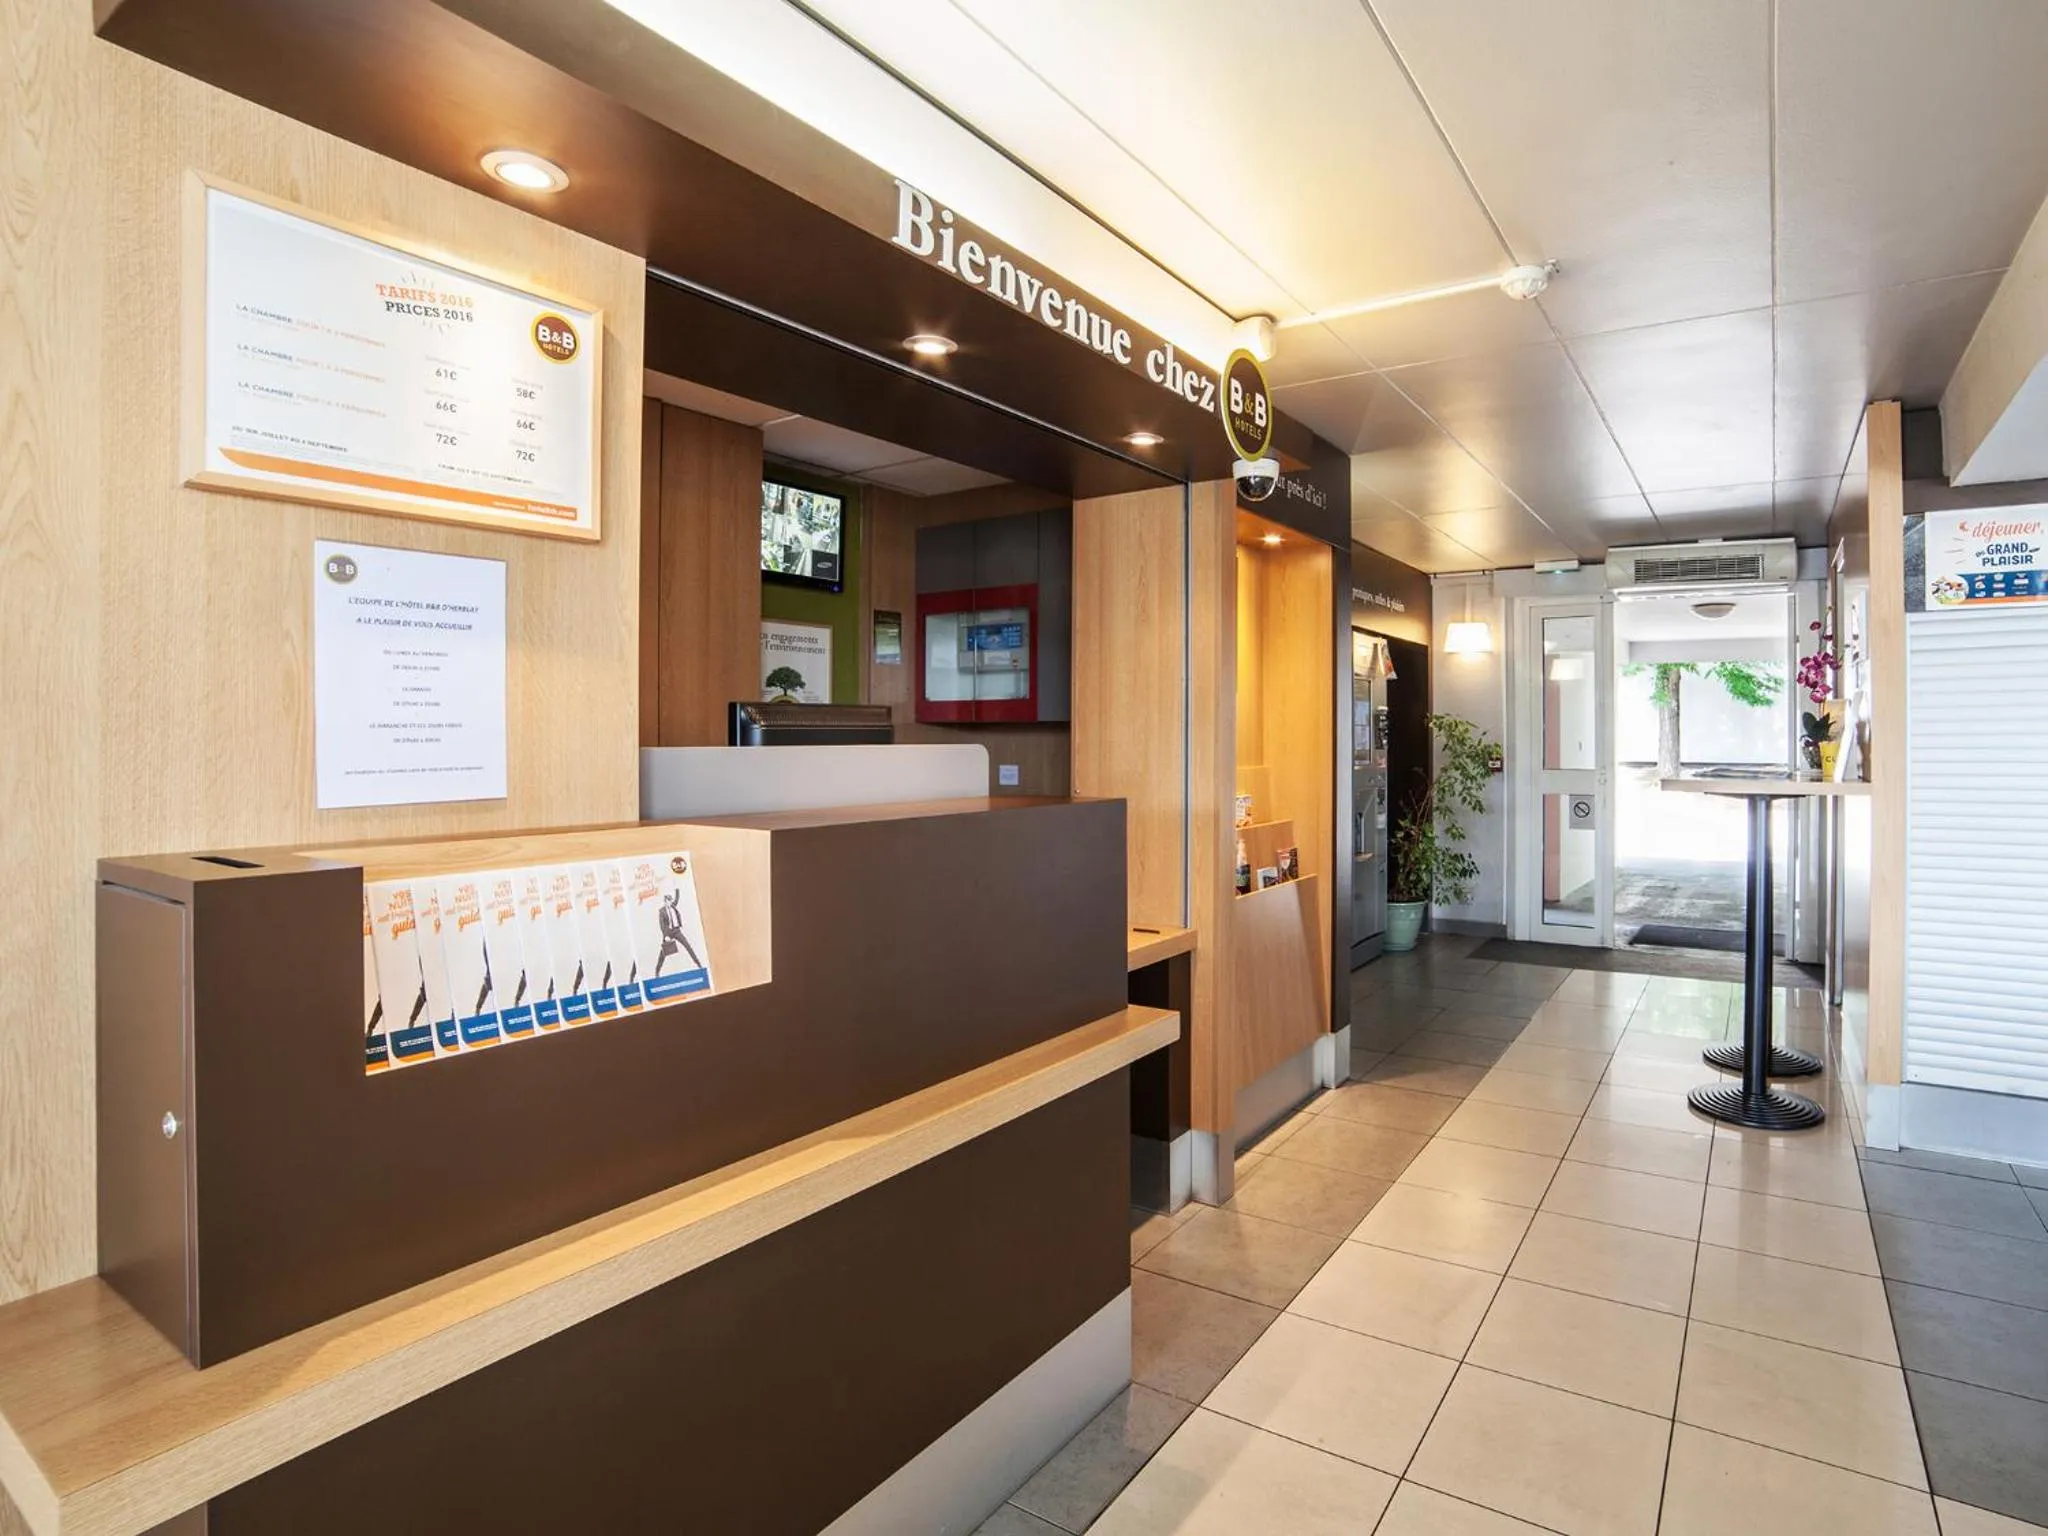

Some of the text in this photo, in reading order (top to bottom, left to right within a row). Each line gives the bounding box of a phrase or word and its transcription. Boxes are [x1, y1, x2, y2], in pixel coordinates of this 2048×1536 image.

[376, 283, 474, 308] TARIFS 2016
[892, 178, 1215, 413] Bienvenue chez
[251, 306, 292, 323] CHAMBRE
[386, 301, 474, 322] PRICES 2016
[538, 323, 575, 350] B&B
[252, 346, 293, 361] CHAMBRE
[435, 368, 457, 380] 61€
[252, 384, 294, 398] CHAMBRE
[516, 387, 536, 399] 58€
[436, 401, 457, 413] 66€
[1230, 377, 1266, 428] B&B
[516, 419, 536, 431] 66€
[1235, 415, 1262, 440] HOTELS
[436, 433, 457, 446] 72€
[515, 450, 536, 462] 72€
[1287, 478, 1304, 499] près
[1986, 542, 2029, 556] GRAND
[1982, 555, 2034, 567] PLAISIR
[374, 618, 401, 626] PLAISIR
